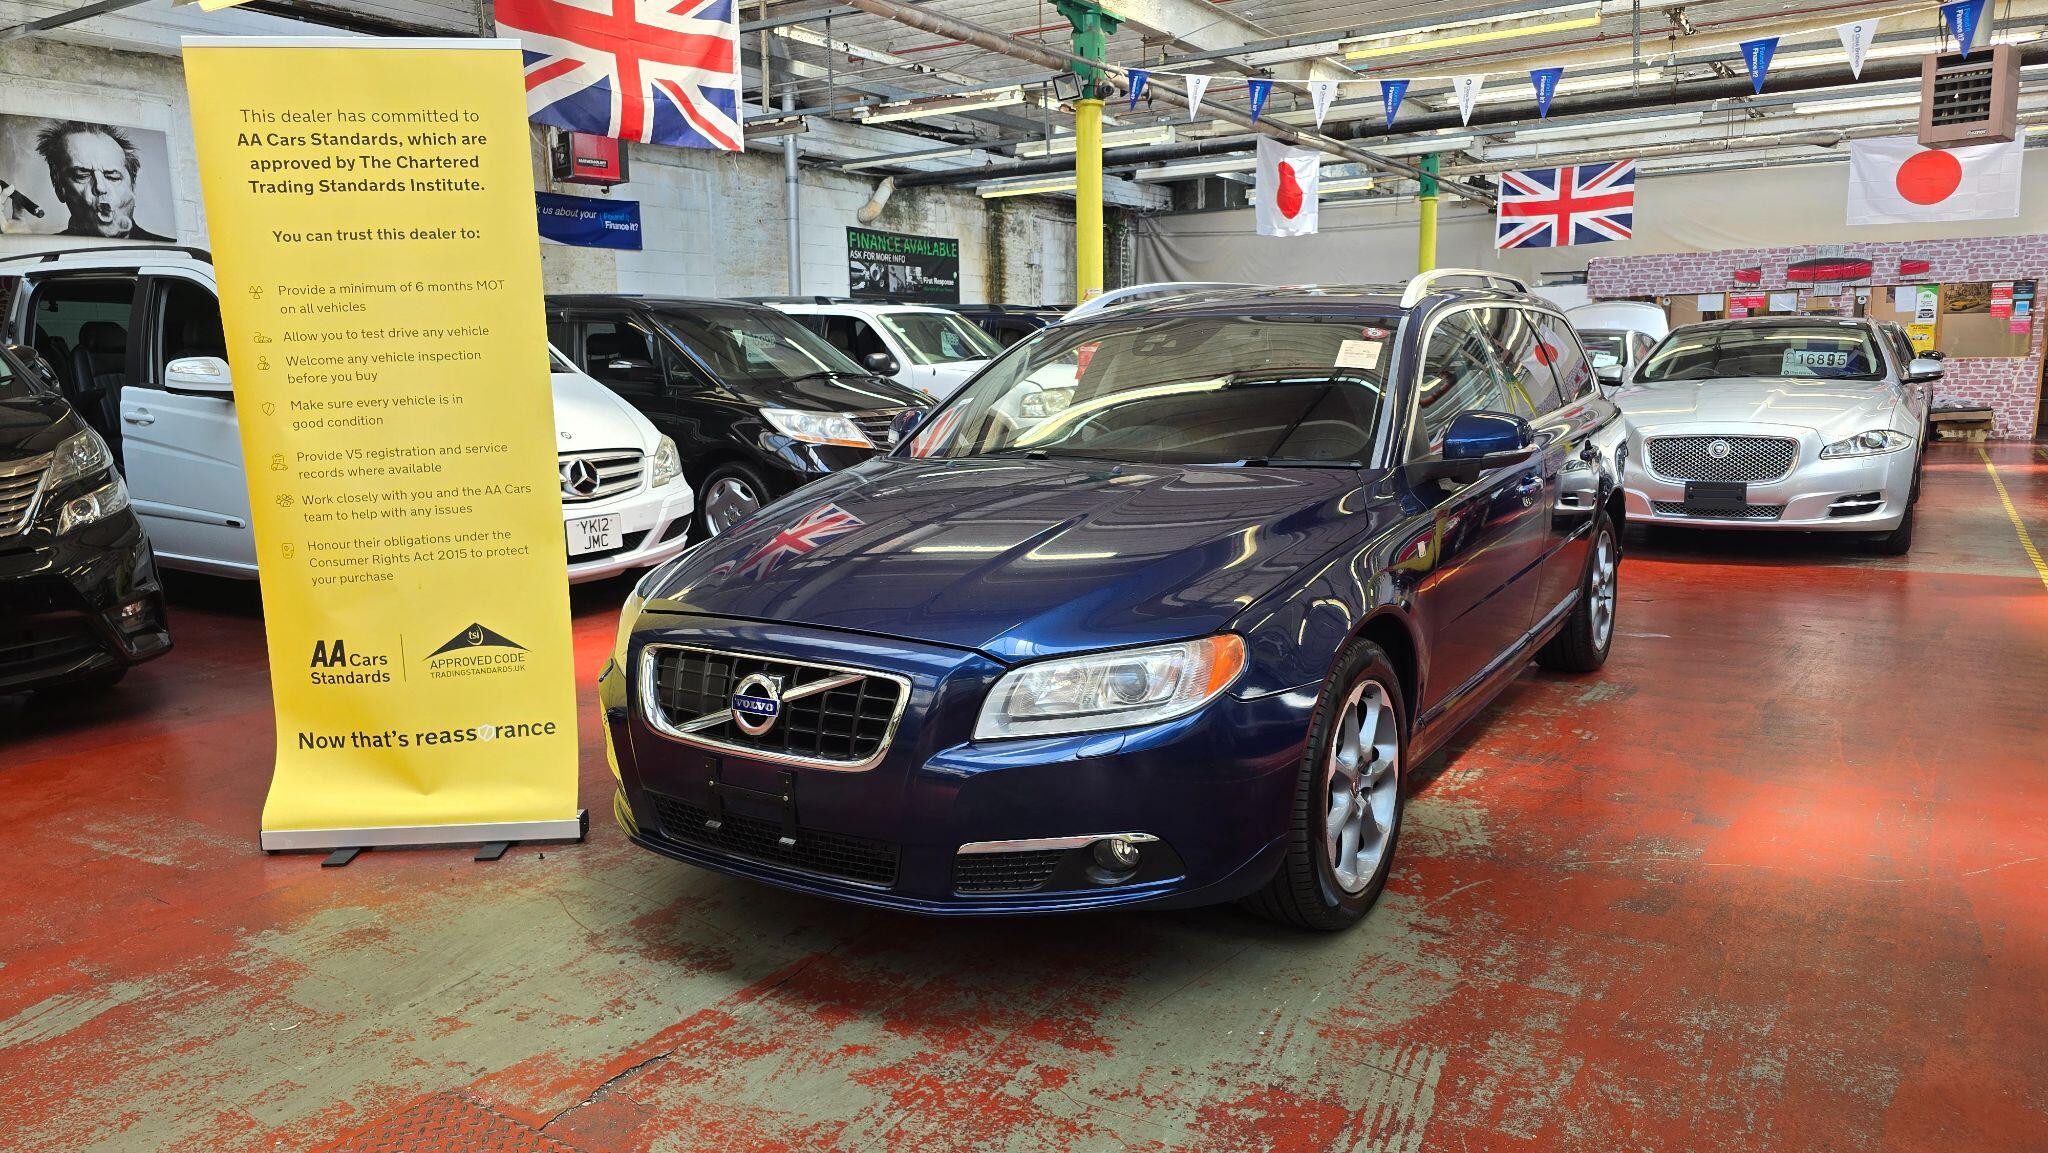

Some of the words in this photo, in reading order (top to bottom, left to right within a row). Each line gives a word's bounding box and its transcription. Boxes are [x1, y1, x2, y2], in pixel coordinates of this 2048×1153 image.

[1956, 9, 1964, 33] Finance
[240, 109, 275, 122] This
[281, 110, 332, 122] dealer
[338, 109, 366, 122] has
[371, 109, 458, 122] committed
[462, 110, 479, 122] to
[238, 133, 262, 146] AA
[267, 133, 306, 146] Cars
[311, 133, 403, 147] Standards,
[407, 132, 456, 145] which
[462, 136, 487, 145] are
[250, 156, 331, 172] approved
[336, 156, 355, 171] by
[359, 156, 391, 168] The
[397, 155, 479, 168] Chartered
[248, 180, 313, 195] Trading
[319, 179, 405, 192] Standards
[411, 179, 484, 191] Institute.
[555, 207, 579, 218] about
[580, 211, 597, 220] your
[605, 221, 629, 230] Finance
[630, 222, 639, 231] it?
[272, 231, 301, 242] You
[306, 233, 332, 241] can
[336, 229, 373, 241] trust
[377, 228, 405, 240] this
[410, 228, 456, 239] dealer
[460, 228, 480, 239] to:
[849, 231, 901, 252] FINANCE
[904, 239, 957, 257] AVAILABLE
[850, 250, 862, 259] ASK
[863, 251, 875, 260] FOR
[876, 253, 891, 262] MORE
[893, 255, 905, 263] INFO
[279, 285, 325, 295] Provide
[340, 283, 396, 293] minimum
[400, 282, 412, 292] of
[416, 282, 423, 291] 6
[428, 281, 473, 291] months
[477, 280, 504, 290] MOT
[934, 277, 954, 287] Response
[300, 303, 314, 313] all
[317, 302, 366, 312] vehicles
[284, 332, 317, 342] Allow
[321, 333, 342, 342] you
[346, 330, 358, 339] to
[361, 329, 384, 339] test
[388, 328, 418, 337] drive
[423, 330, 443, 339] any
[447, 326, 489, 336] vehicle
[286, 356, 344, 366] Welcome
[348, 356, 368, 365] any
[371, 352, 414, 362] vehicle
[419, 350, 481, 362] inspection
[288, 373, 327, 383] before
[331, 374, 352, 384] you
[356, 371, 377, 382] buy
[291, 400, 323, 410] Make
[328, 401, 353, 409] sure
[357, 399, 389, 408] every
[392, 395, 435, 406] vehicle
[440, 395, 449, 404] is
[453, 394, 463, 403] in
[293, 418, 323, 431] good
[328, 416, 383, 427] condition
[297, 451, 342, 462] Provide
[346, 449, 362, 459] V5
[367, 446, 435, 460] registration
[440, 444, 461, 455] and
[466, 443, 508, 453] service
[299, 468, 344, 479] records
[348, 466, 384, 476] where
[389, 463, 441, 474] available
[302, 494, 333, 505] Work
[337, 492, 378, 503] closely
[382, 490, 407, 500] with
[411, 491, 432, 501] you
[437, 487, 458, 497] and
[462, 487, 481, 496] the
[485, 485, 501, 495] AA
[505, 484, 531, 494] Cars
[304, 513, 332, 522] team
[336, 511, 348, 520] to
[352, 509, 377, 520] help
[381, 507, 406, 518] with
[411, 508, 431, 517] any
[435, 505, 472, 515] issues
[580, 518, 609, 534] YK12
[308, 541, 351, 551] Honour
[354, 539, 380, 548] their
[384, 534, 451, 547] obligations
[455, 532, 489, 542] under
[492, 530, 511, 539] the
[584, 534, 608, 550] JMC
[310, 556, 369, 567] Consumer
[373, 553, 410, 565] Rights
[414, 552, 434, 561] Act
[438, 549, 467, 560] 2015
[471, 549, 482, 558] to
[487, 545, 528, 558] protect
[312, 577, 336, 586] your
[340, 573, 393, 585] purchase
[467, 631, 480, 640] tsi
[310, 640, 346, 668] AA
[350, 654, 388, 666] Cars
[430, 655, 492, 669] APPROVED
[495, 653, 525, 664] CODE
[311, 670, 390, 684] Standards
[430, 664, 525, 679] TRADINGSTANDARDS.UK
[736, 698, 774, 711] VOLVO
[299, 732, 345, 749] Now
[416, 722, 556, 746] reassrance
